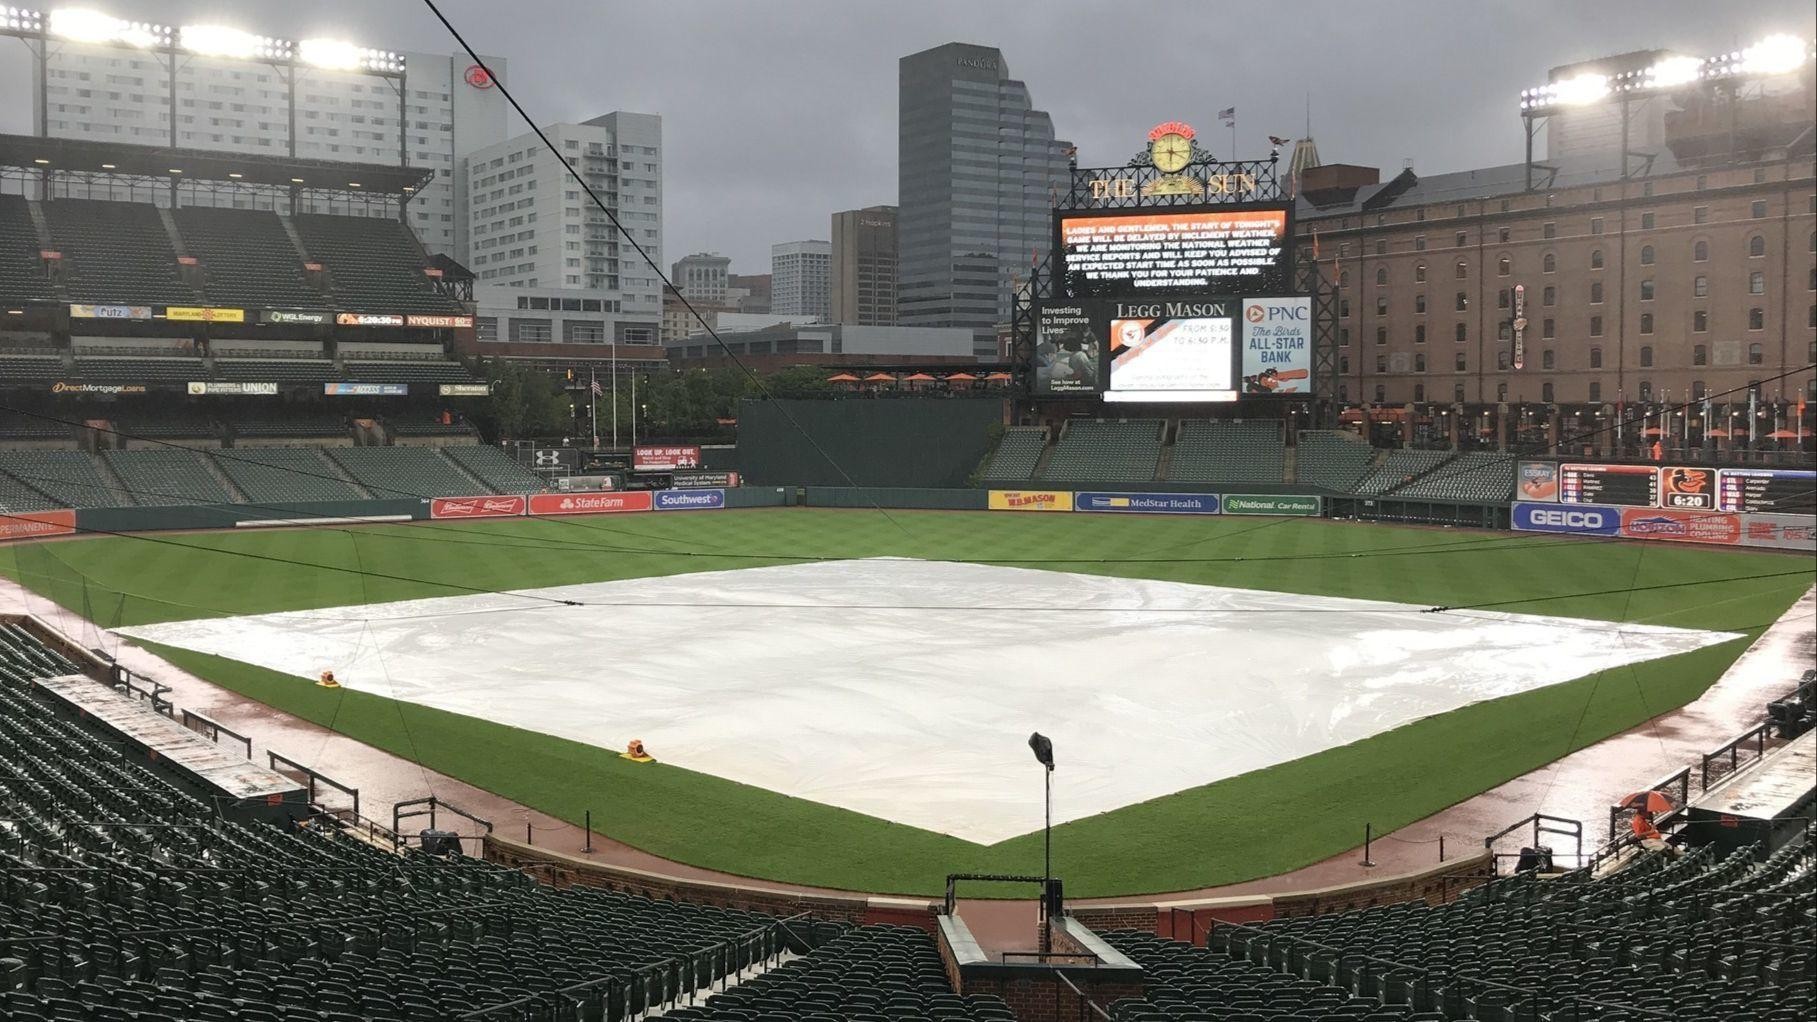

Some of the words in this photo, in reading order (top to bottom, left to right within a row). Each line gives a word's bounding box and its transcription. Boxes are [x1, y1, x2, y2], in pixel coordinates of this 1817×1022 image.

[1089, 178, 1136, 199] THE
[1208, 174, 1256, 194] SUN
[1066, 226, 1096, 234] LADIES
[1190, 222, 1218, 230] START
[1234, 220, 1280, 228] TONIGHT'S
[1066, 236, 1091, 244] GAME
[1092, 234, 1112, 242] WILL
[1114, 234, 1126, 242] BE
[1127, 232, 1166, 242] DELAYED
[1181, 230, 1230, 240] INCLEMENT
[1076, 244, 1088, 252] WE
[1109, 242, 1162, 251] MONITORING
[1163, 242, 1180, 250] THE
[1182, 240, 1226, 248] NATIONAL
[1227, 239, 1270, 248] WEATHER
[1065, 253, 1100, 262] SERVICE
[1102, 252, 1141, 260] REPORTS
[1142, 252, 1160, 260] AND
[1162, 250, 1182, 258] WILL
[1184, 250, 1208, 258] KEEP
[1229, 248, 1267, 257] ADVISED
[1268, 248, 1282, 256] OF
[1068, 263, 1080, 271] AN
[1082, 262, 1124, 270] EXPECTED
[1126, 261, 1154, 269] START
[1155, 260, 1176, 268] TIME
[1177, 260, 1190, 268] AS
[1191, 259, 1215, 267] SOON
[1216, 258, 1229, 266] AS
[1086, 272, 1098, 280] WE
[1100, 270, 1130, 279] THANK
[1130, 270, 1150, 278] YOU
[1150, 270, 1168, 278] FOR
[1169, 268, 1194, 277] YOUR
[1195, 268, 1238, 276] PATIENCE
[1240, 267, 1260, 275] AND
[1134, 278, 1208, 287] UNDERSTANDING.
[1042, 306, 1082, 315] Investing
[1116, 304, 1160, 318] LEGG
[1165, 302, 1225, 317] MASON
[1267, 306, 1308, 320] PNC
[298, 313, 323, 322] Energy
[1053, 316, 1090, 325] Improve
[1183, 324, 1208, 334] FROM
[1252, 326, 1271, 336] The
[1273, 325, 1302, 336] Birds
[1249, 337, 1304, 350] ALL-STAR
[1260, 351, 1292, 363] BANK
[242, 382, 277, 392] UNION
[662, 494, 711, 505] Southwest
[1131, 499, 1168, 507] MedStar
[1170, 499, 1201, 508] Health
[1239, 500, 1274, 509] National
[1674, 496, 1703, 506] 6:20
[1530, 510, 1602, 528] GEICO
[1690, 514, 1727, 525] HEATING
[1690, 524, 1734, 532] PLUMBING
[1690, 531, 1728, 540] COOLING
